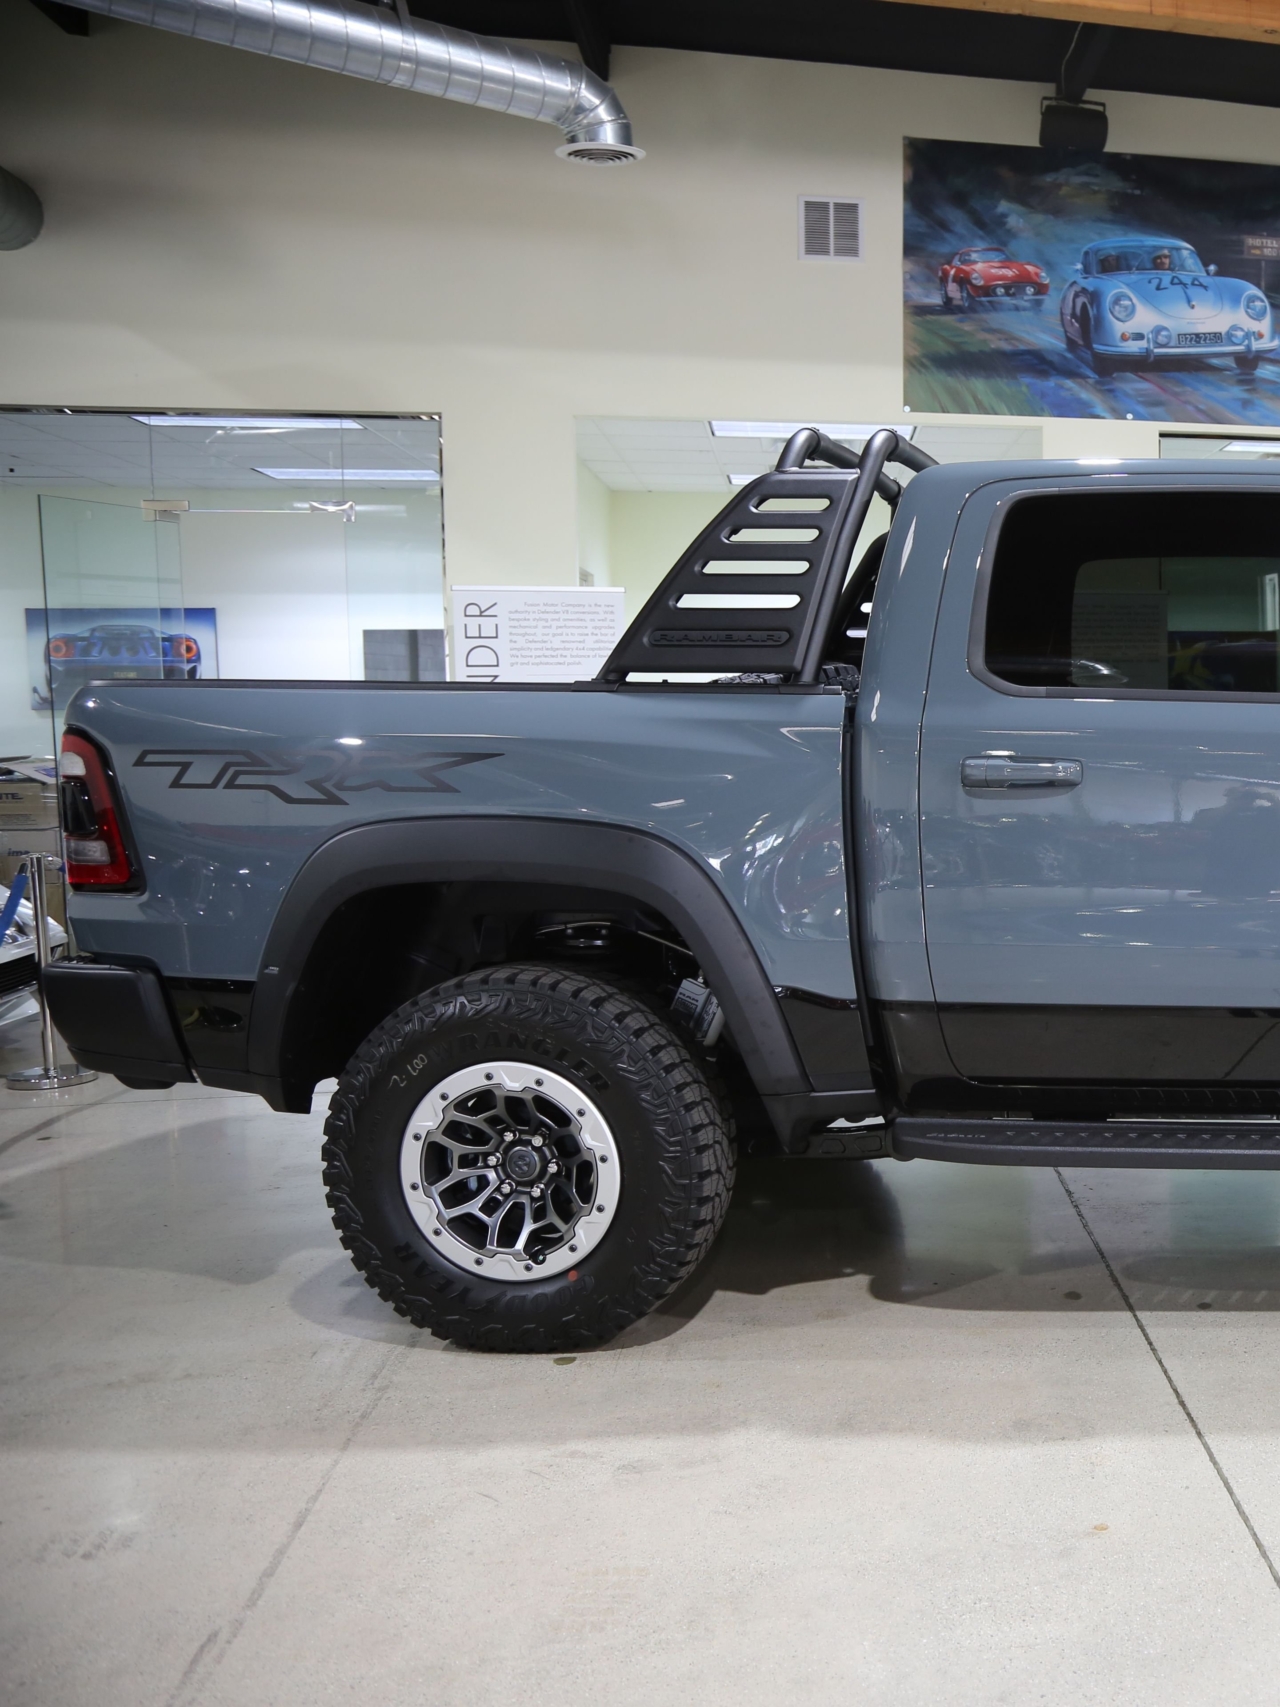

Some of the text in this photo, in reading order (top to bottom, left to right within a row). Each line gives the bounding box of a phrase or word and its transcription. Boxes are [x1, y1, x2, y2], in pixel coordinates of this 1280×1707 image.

[1248, 238, 1279, 247] HOTEL
[1263, 247, 1278, 256] 100
[1147, 275, 1209, 291] 244
[652, 633, 782, 642] RAMBAR
[132, 749, 505, 805] TRX
[431, 1029, 611, 1095] WRANGLER
